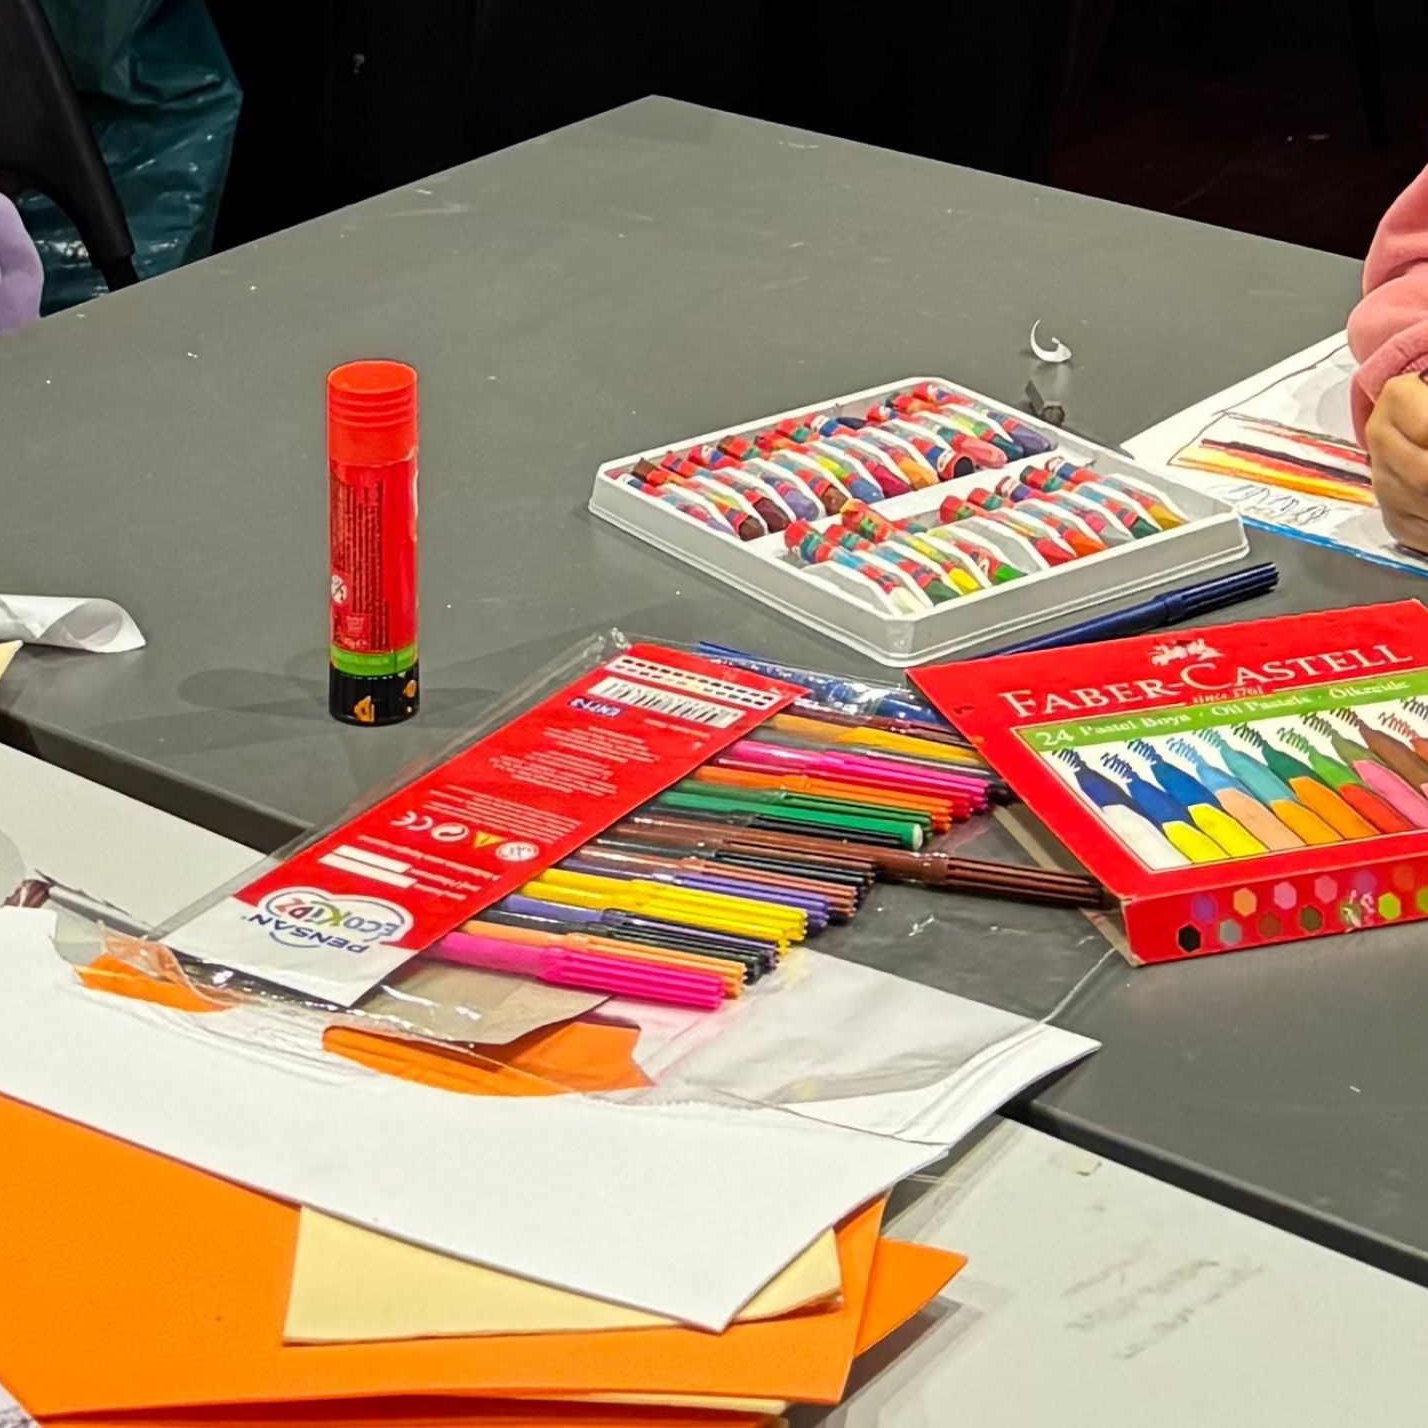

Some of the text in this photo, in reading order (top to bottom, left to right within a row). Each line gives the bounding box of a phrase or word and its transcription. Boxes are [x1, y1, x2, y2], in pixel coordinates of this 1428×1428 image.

[998, 644, 1414, 718] FABER-CASTELL
[1192, 685, 1263, 705] since 1761
[1035, 729, 1075, 746] 24
[1079, 720, 1137, 737] Pastel
[1211, 703, 1242, 718] Oil
[1245, 695, 1313, 713] Pastels
[248, 913, 371, 953] PENSAN
